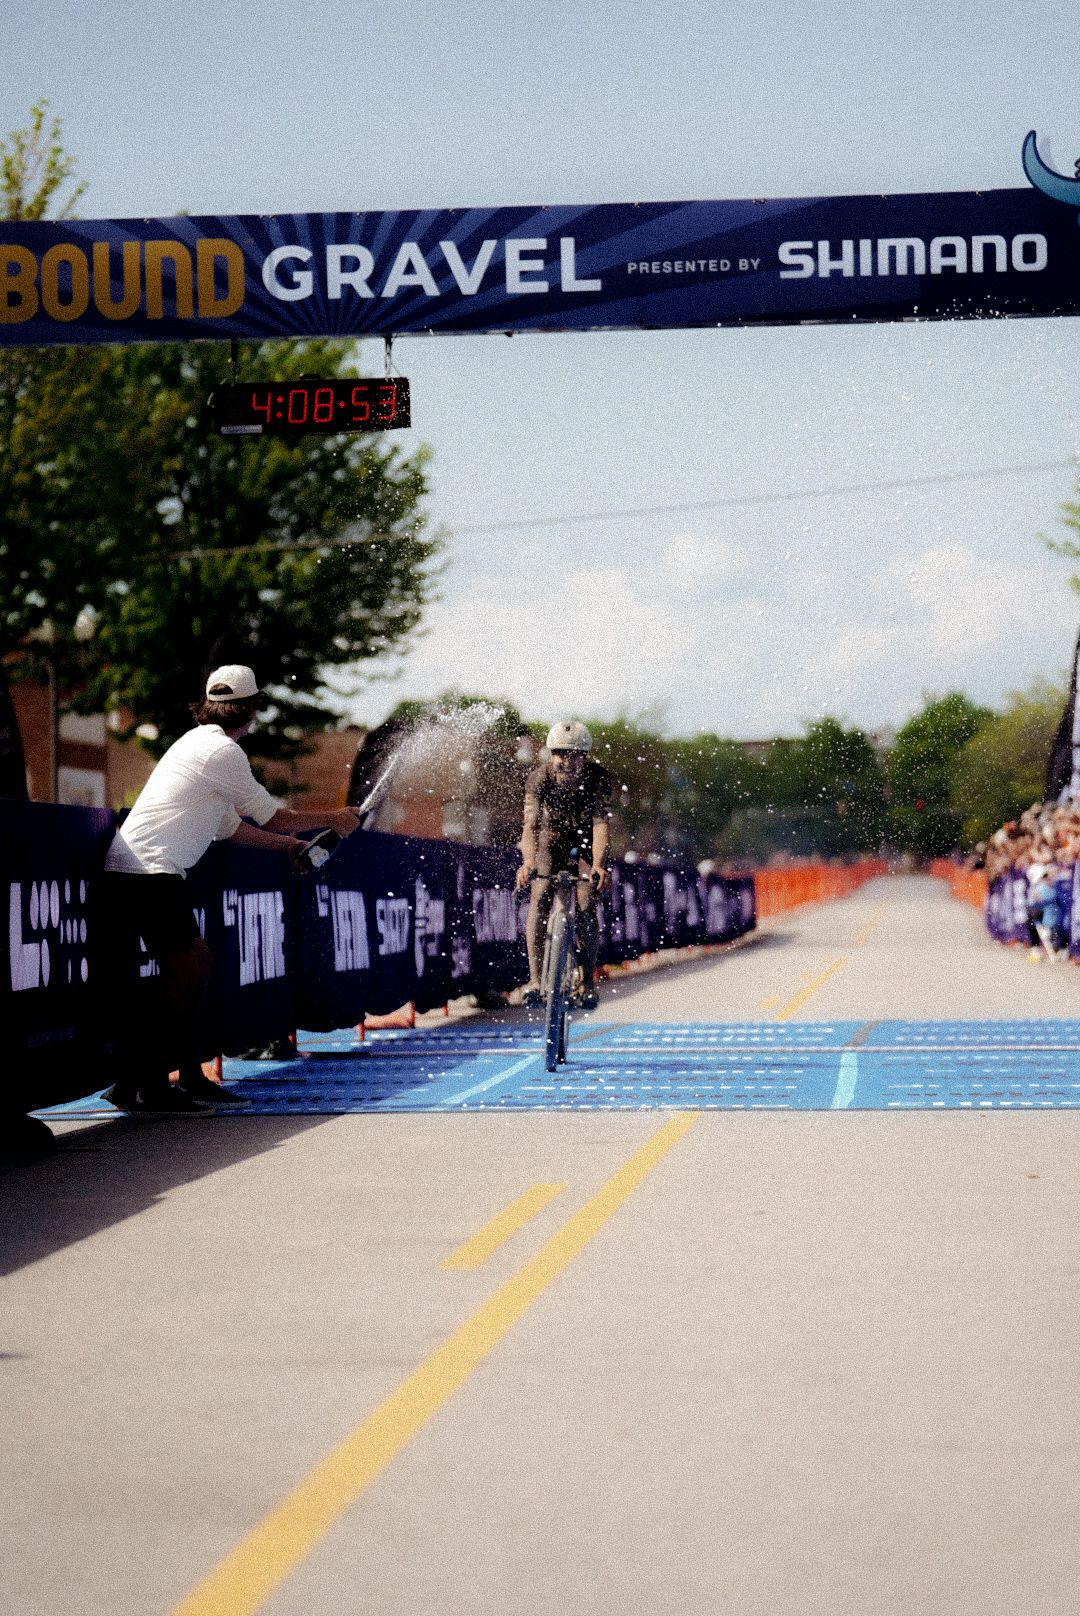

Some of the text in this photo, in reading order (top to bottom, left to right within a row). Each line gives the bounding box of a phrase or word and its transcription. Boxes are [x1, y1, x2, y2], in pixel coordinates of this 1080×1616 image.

[0, 233, 1048, 322] BOUND GRAVEL PRESENTED BY SHIMANO
